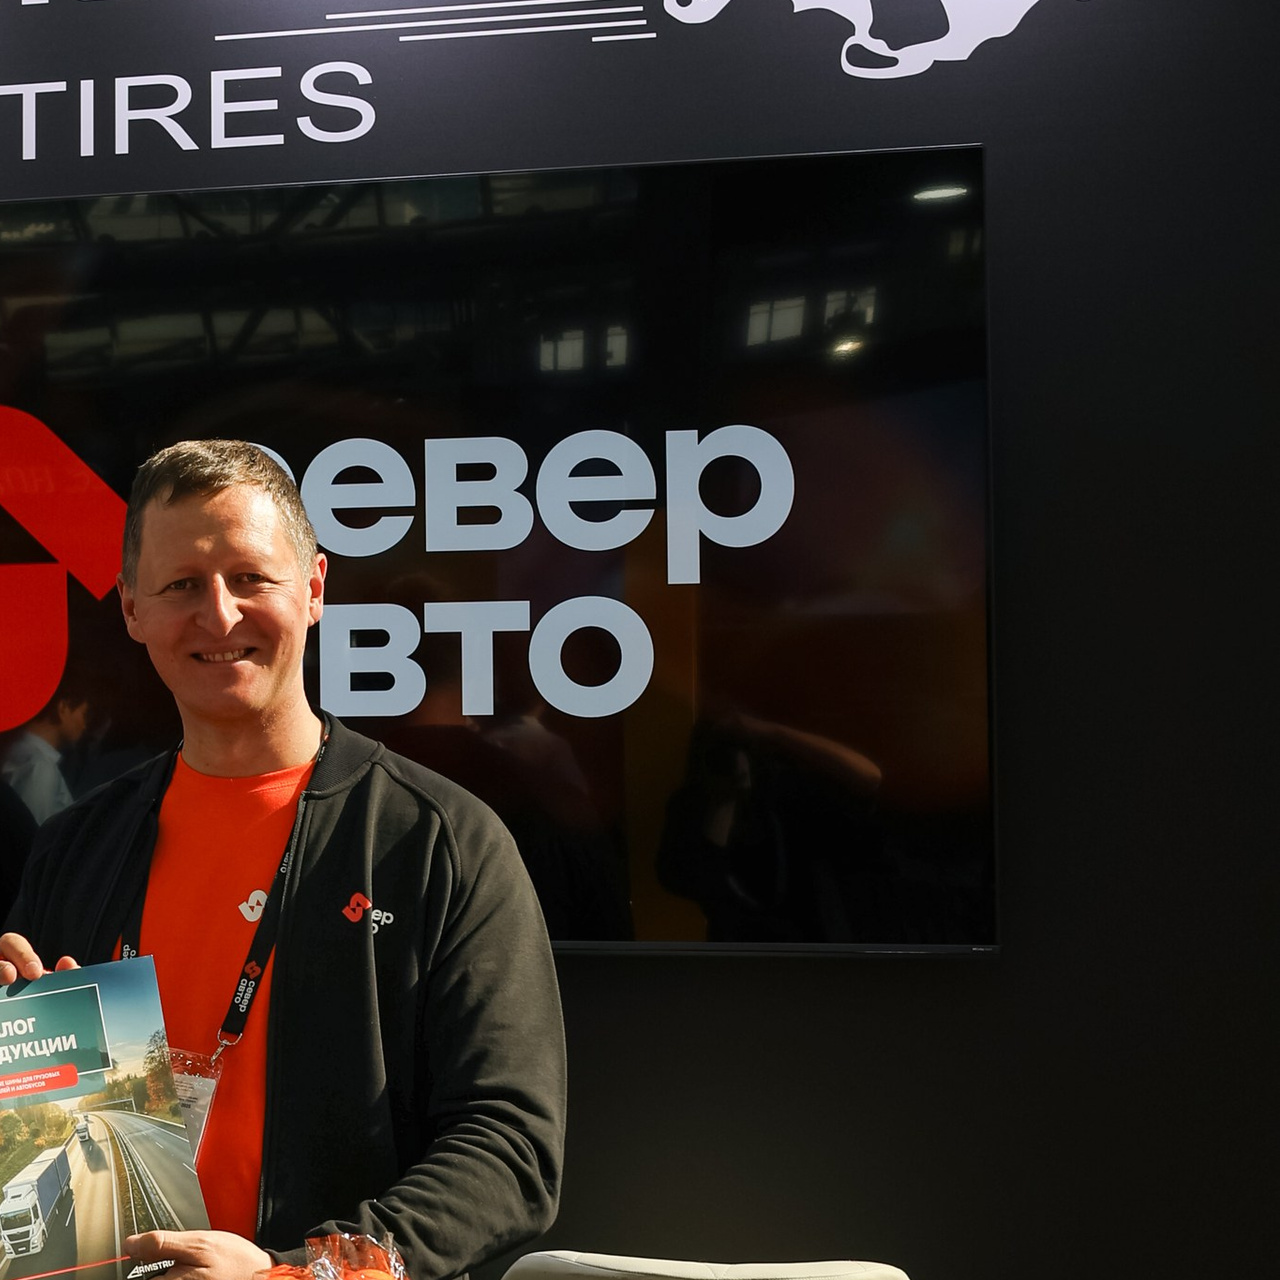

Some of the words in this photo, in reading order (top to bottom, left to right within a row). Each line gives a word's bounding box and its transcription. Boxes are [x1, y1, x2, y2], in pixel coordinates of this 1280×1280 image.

[247, 424, 796, 585] евер
[318, 596, 655, 718] вто
[234, 978, 248, 1004] авто
[239, 980, 256, 1012] север
[5, 1079, 22, 1087] ШИНЫ
[22, 1076, 33, 1085] ДЛЯ
[33, 1071, 61, 1081] ГРУЗОВЫХ
[15, 1081, 46, 1091] АВТОБУСОВ
